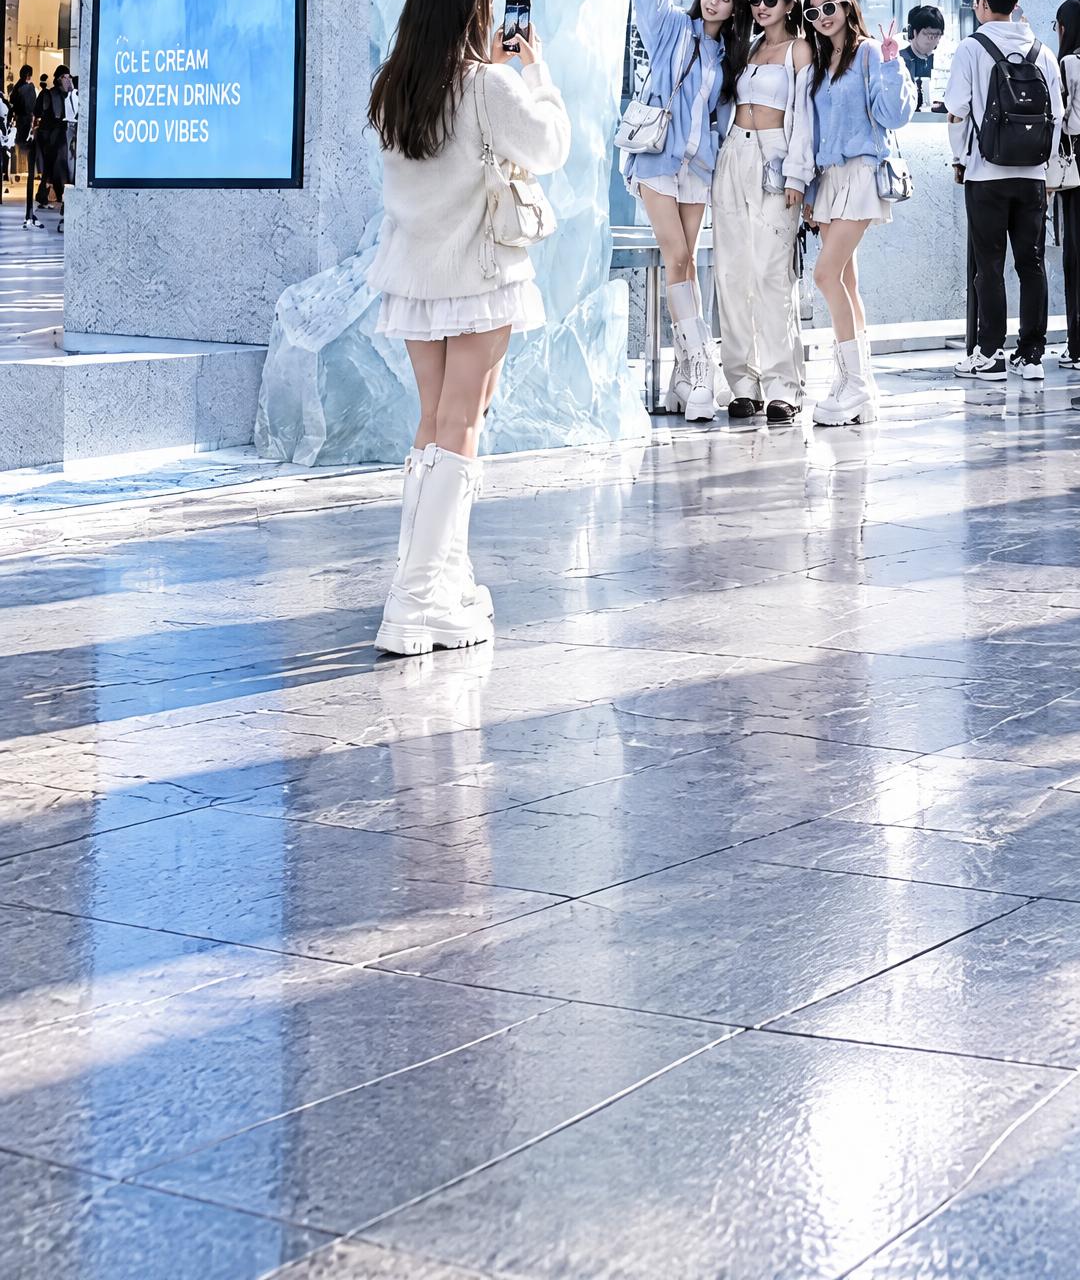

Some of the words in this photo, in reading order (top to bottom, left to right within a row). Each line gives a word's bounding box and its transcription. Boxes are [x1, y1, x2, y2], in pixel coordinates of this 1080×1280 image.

[155, 48, 209, 73] CREAM
[114, 85, 179, 108] FROZEN
[183, 82, 241, 107] DRINKS
[113, 120, 160, 143] GOOD
[164, 119, 209, 143] VIBES
